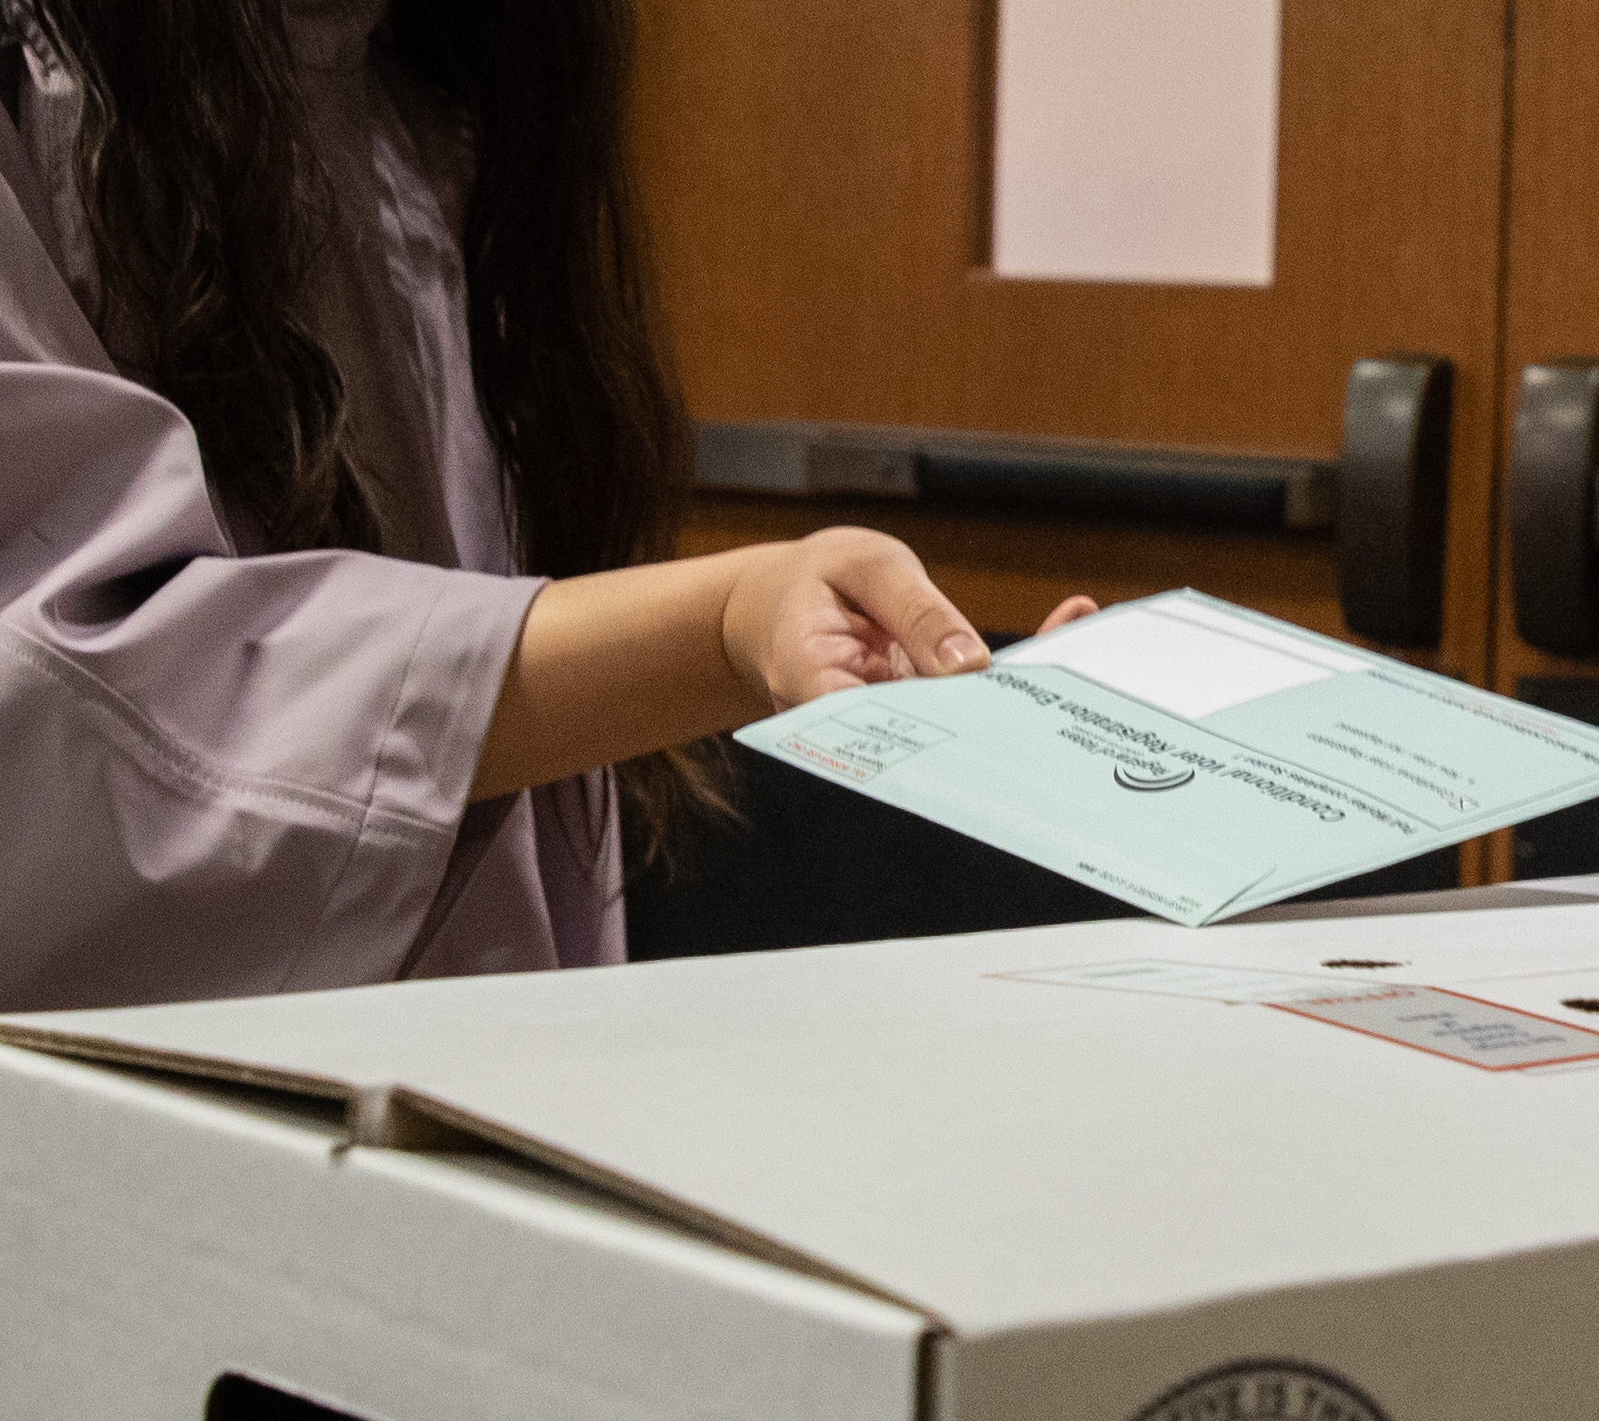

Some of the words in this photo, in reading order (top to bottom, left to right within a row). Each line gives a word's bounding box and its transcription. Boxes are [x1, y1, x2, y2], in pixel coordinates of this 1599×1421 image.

[1057, 699, 1177, 756] Registration
[1169, 750, 1227, 777] Voter
[1220, 768, 1347, 824] Conditional
